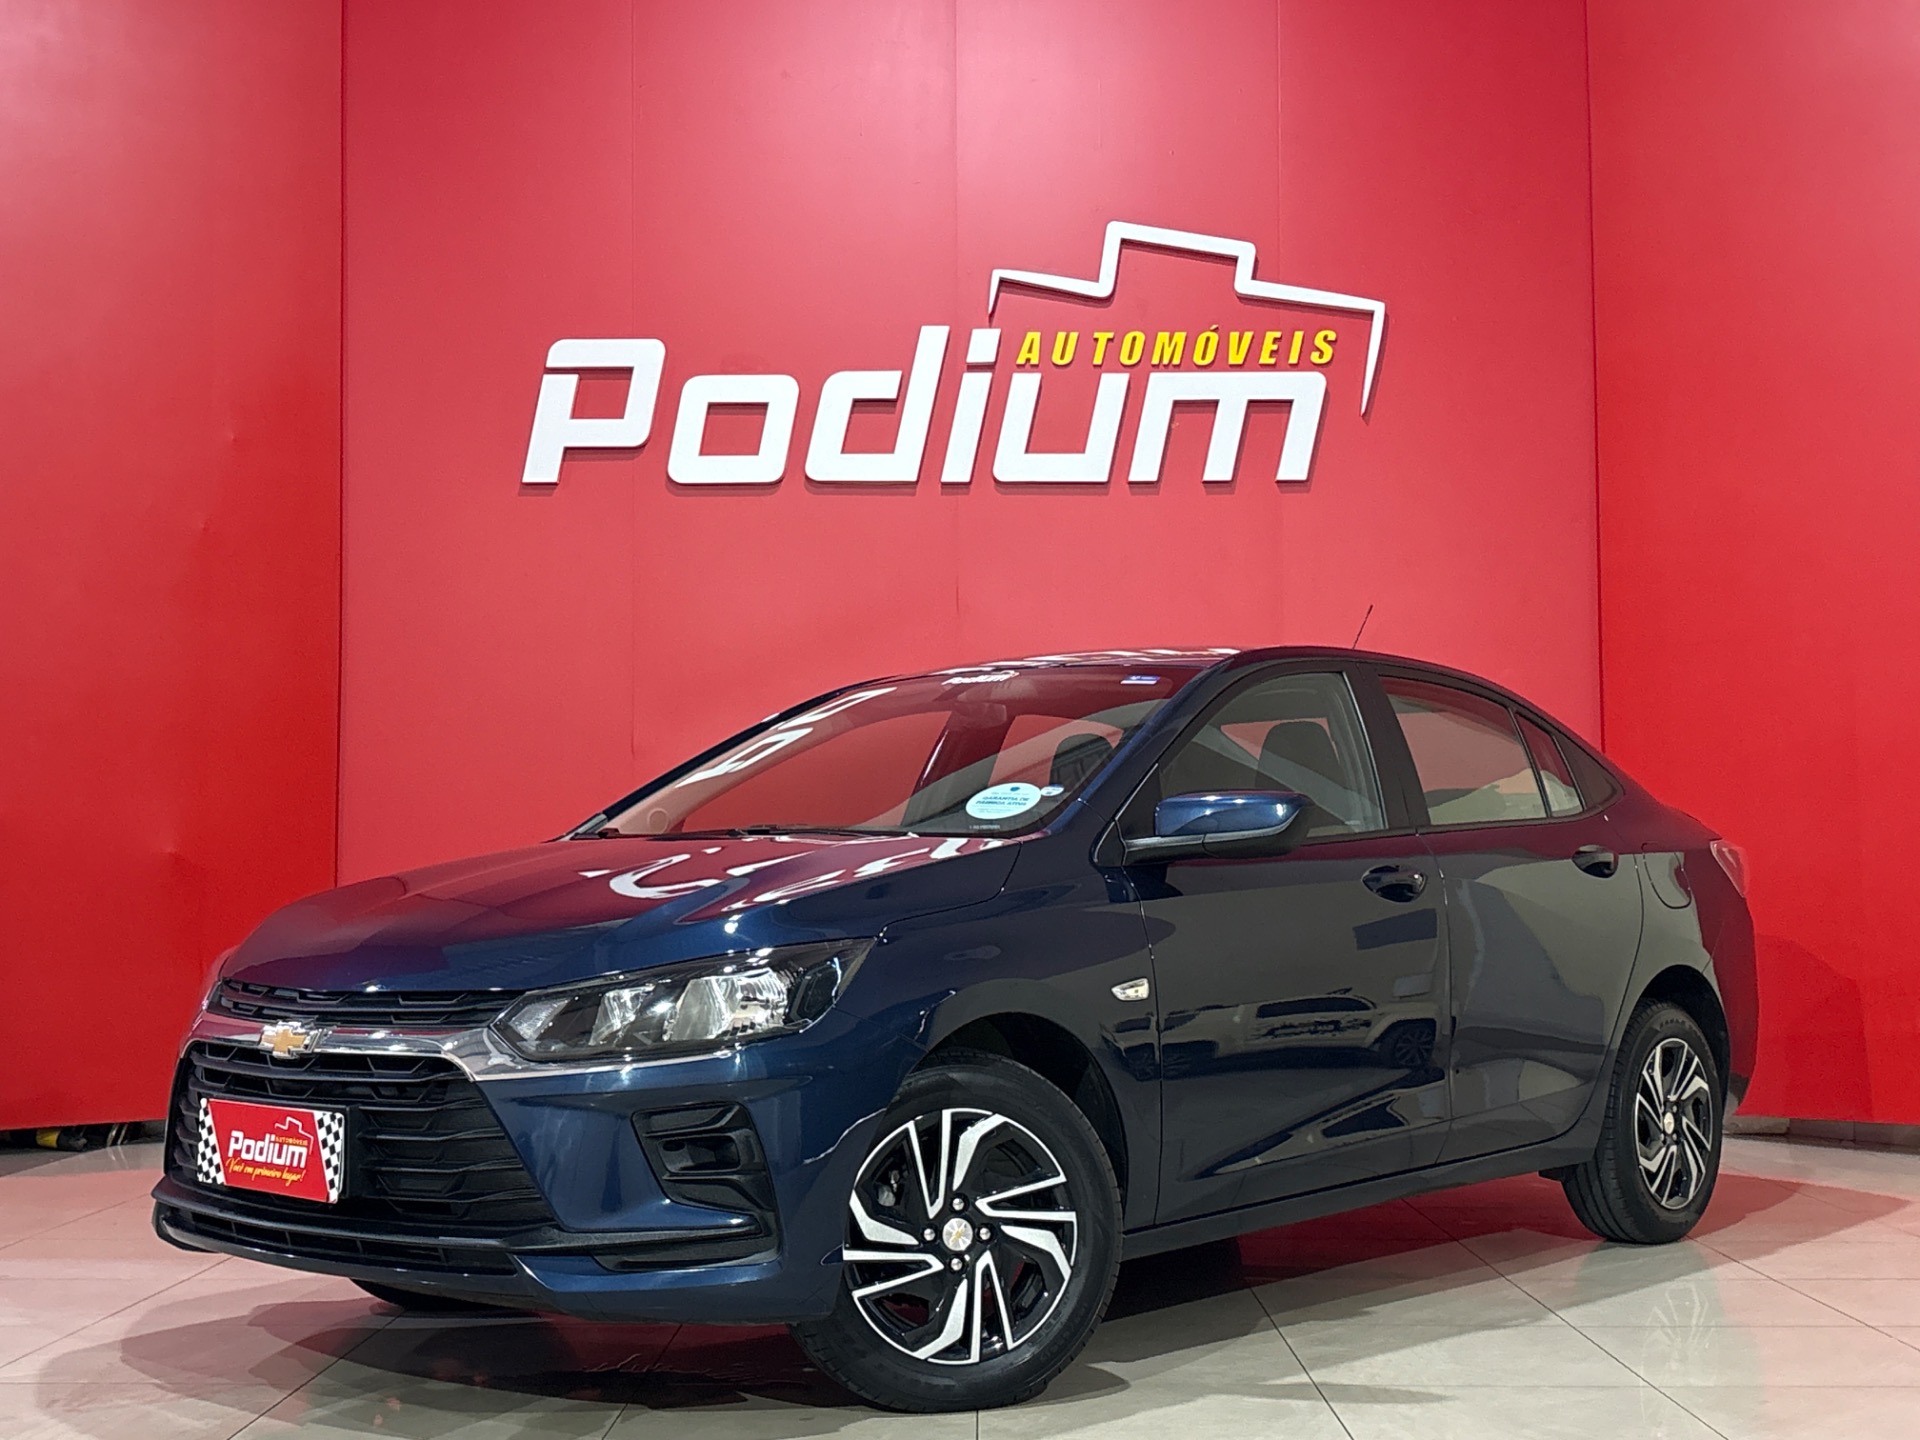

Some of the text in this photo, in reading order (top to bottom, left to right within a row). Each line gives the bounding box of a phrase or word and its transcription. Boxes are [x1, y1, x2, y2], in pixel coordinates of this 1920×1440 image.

[1015, 324, 1337, 366] AUTOMÓVEIS
[522, 325, 1327, 484] Podium
[228, 1129, 308, 1169] Podium
